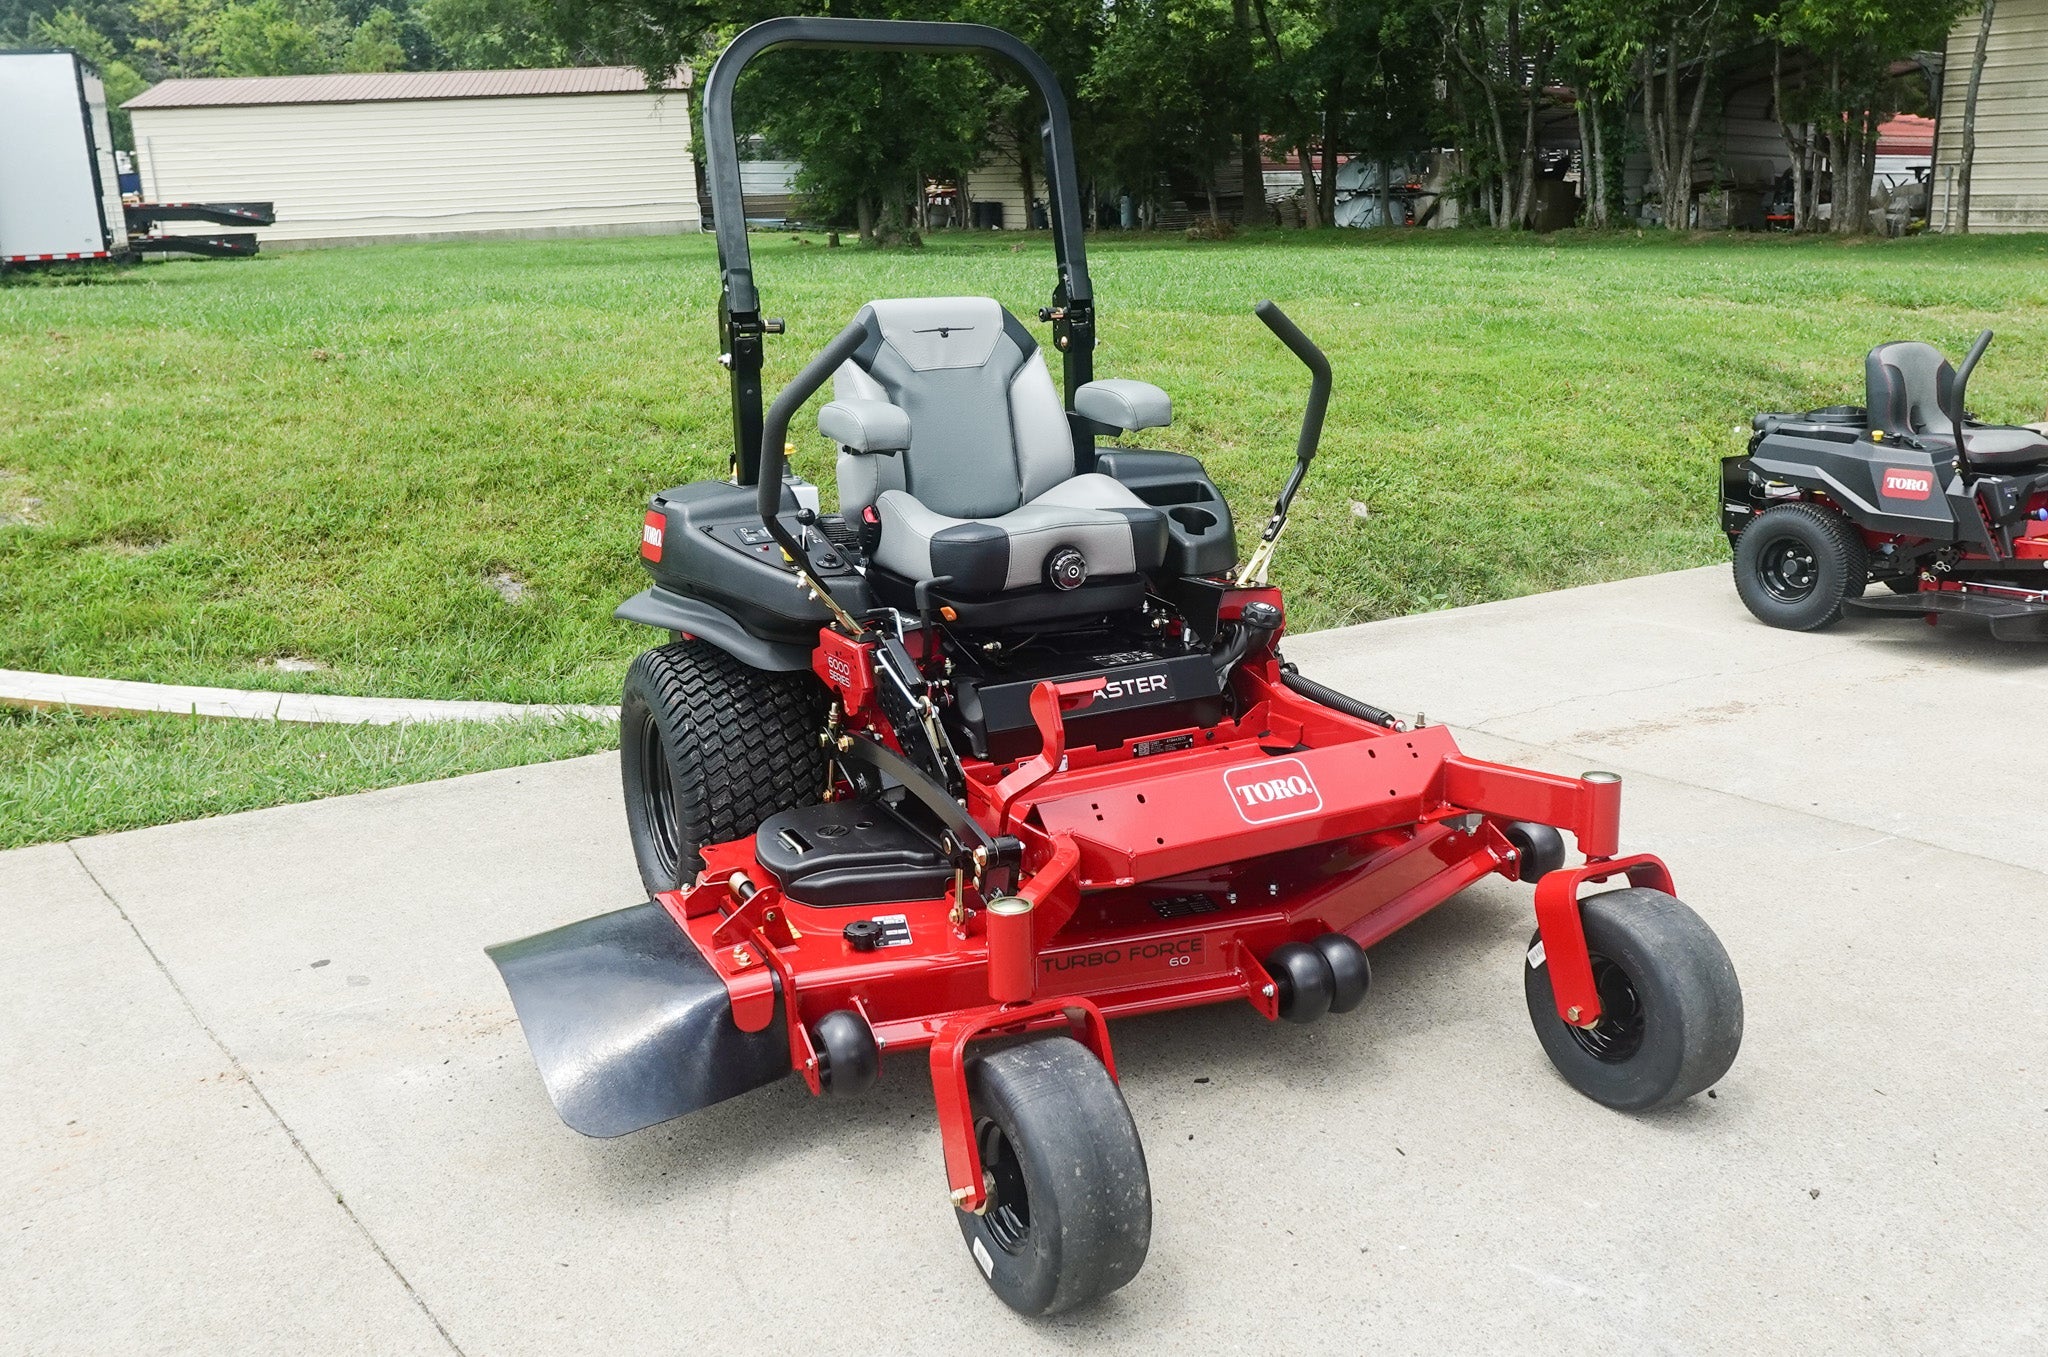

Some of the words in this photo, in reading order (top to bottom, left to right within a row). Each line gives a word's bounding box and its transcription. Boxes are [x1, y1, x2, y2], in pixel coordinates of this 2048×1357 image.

[828, 656, 850, 676] 6000
[828, 669, 851, 688] SERIES
[1093, 674, 1167, 700] ASTER
[1041, 950, 1121, 973] TURBO
[1129, 938, 1203, 961] FORCE
[1169, 955, 1191, 967] 60
